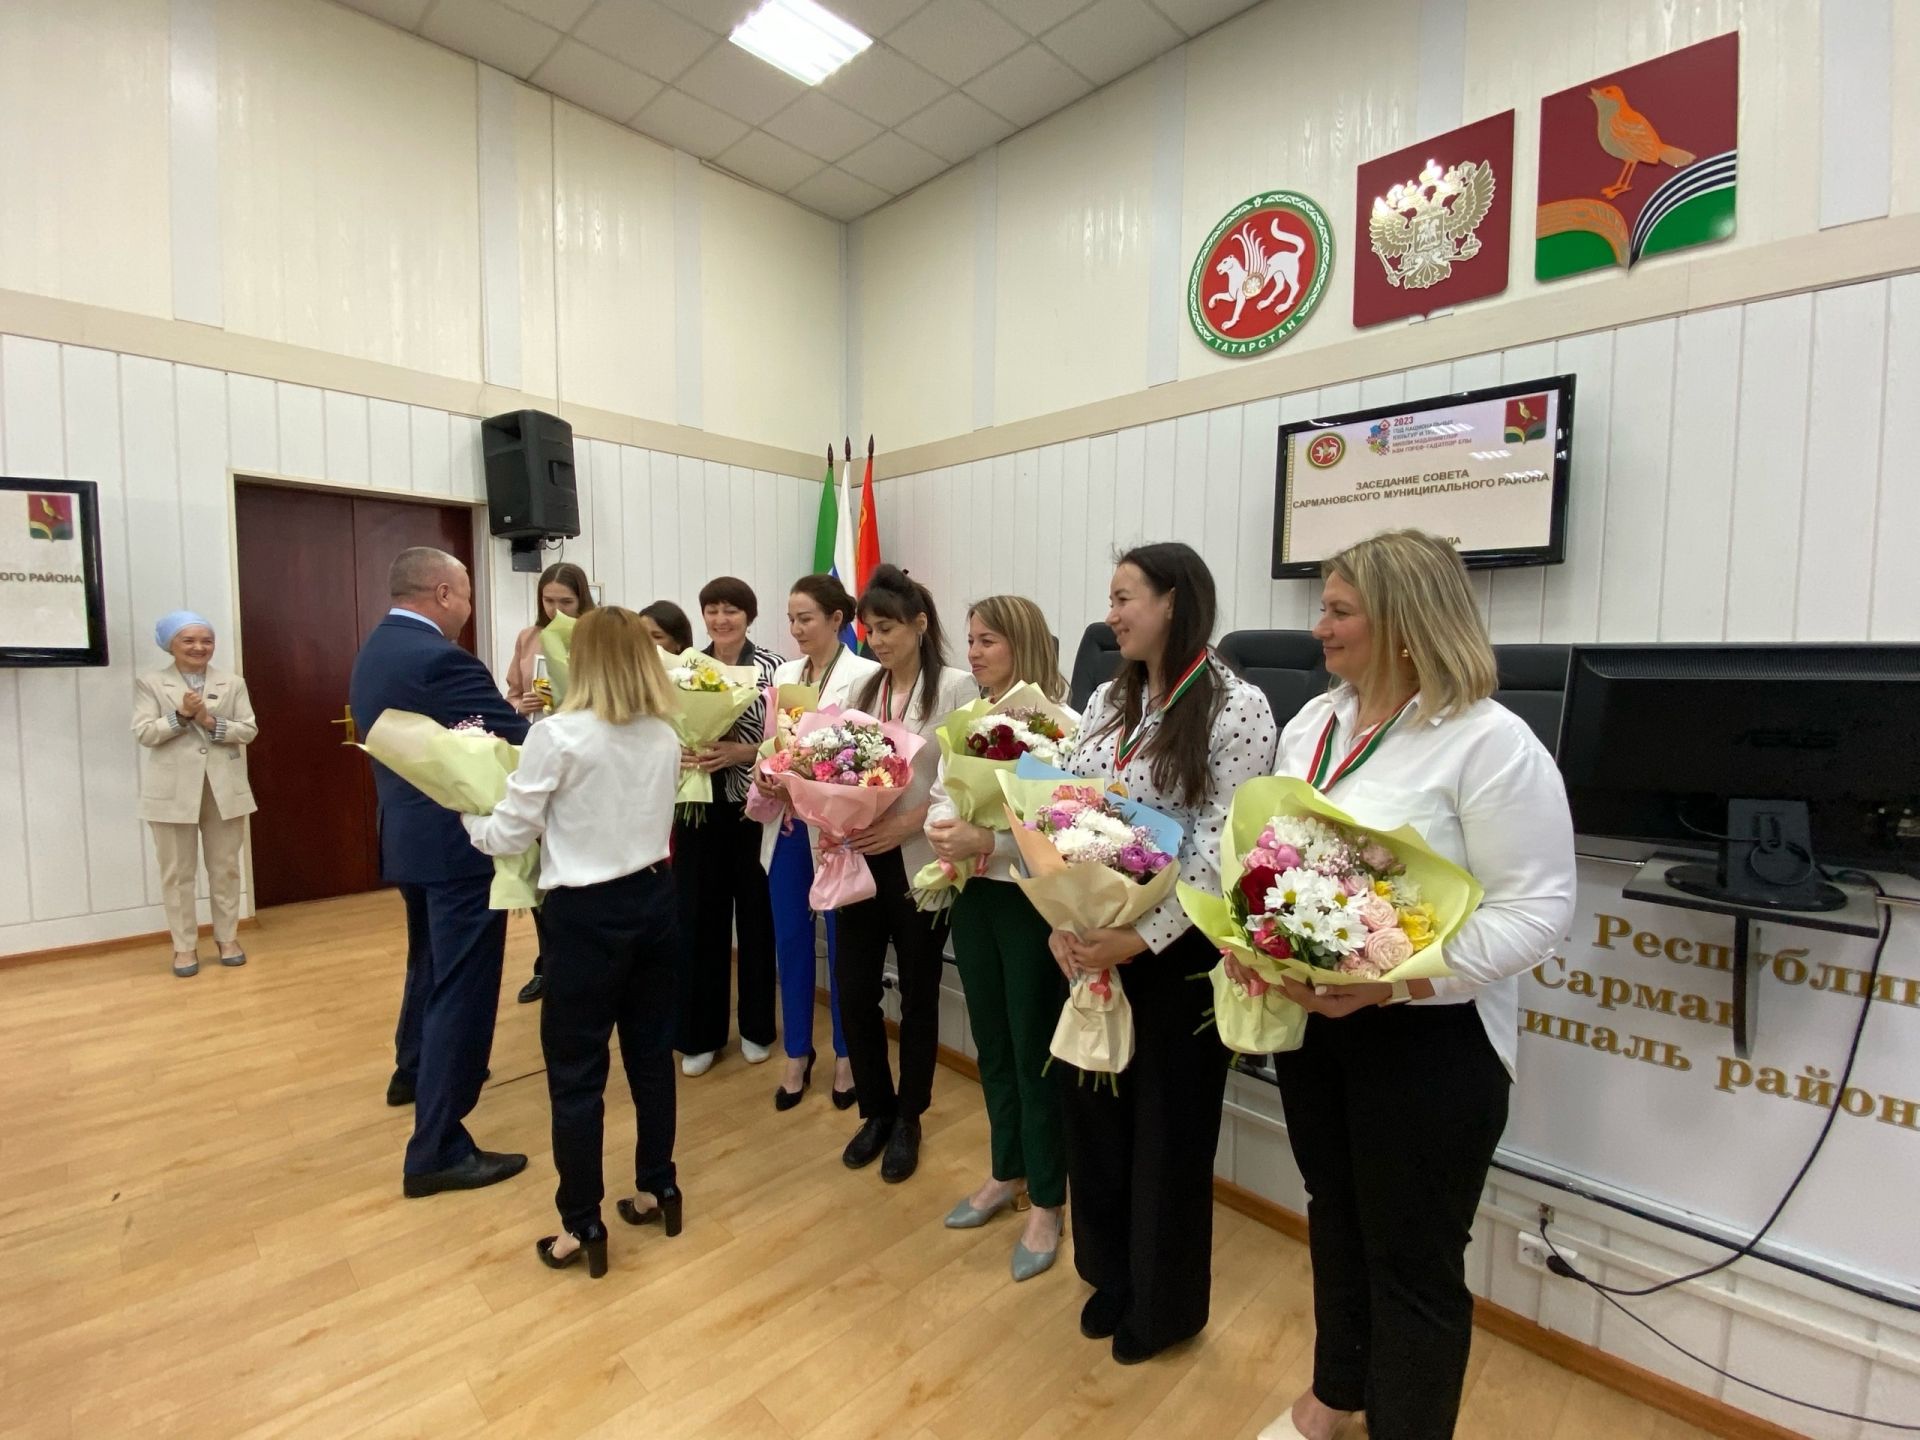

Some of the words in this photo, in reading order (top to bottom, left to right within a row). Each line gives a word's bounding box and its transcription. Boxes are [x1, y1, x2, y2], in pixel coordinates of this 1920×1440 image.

[1214, 319, 1297, 354] ТАТАРСТАН
[1394, 416, 1413, 426] 2023
[1355, 474, 1420, 491] ЗАСЕДАНИЕ
[1422, 468, 1470, 483] СОВЕТА
[1292, 490, 1381, 509] САРМАНОВСКОГО
[1383, 478, 1496, 499] МУНИЦИПАЛЬНОГО
[29, 571, 83, 585] РАЙОНА
[1518, 1007, 1693, 1072] ипаль
